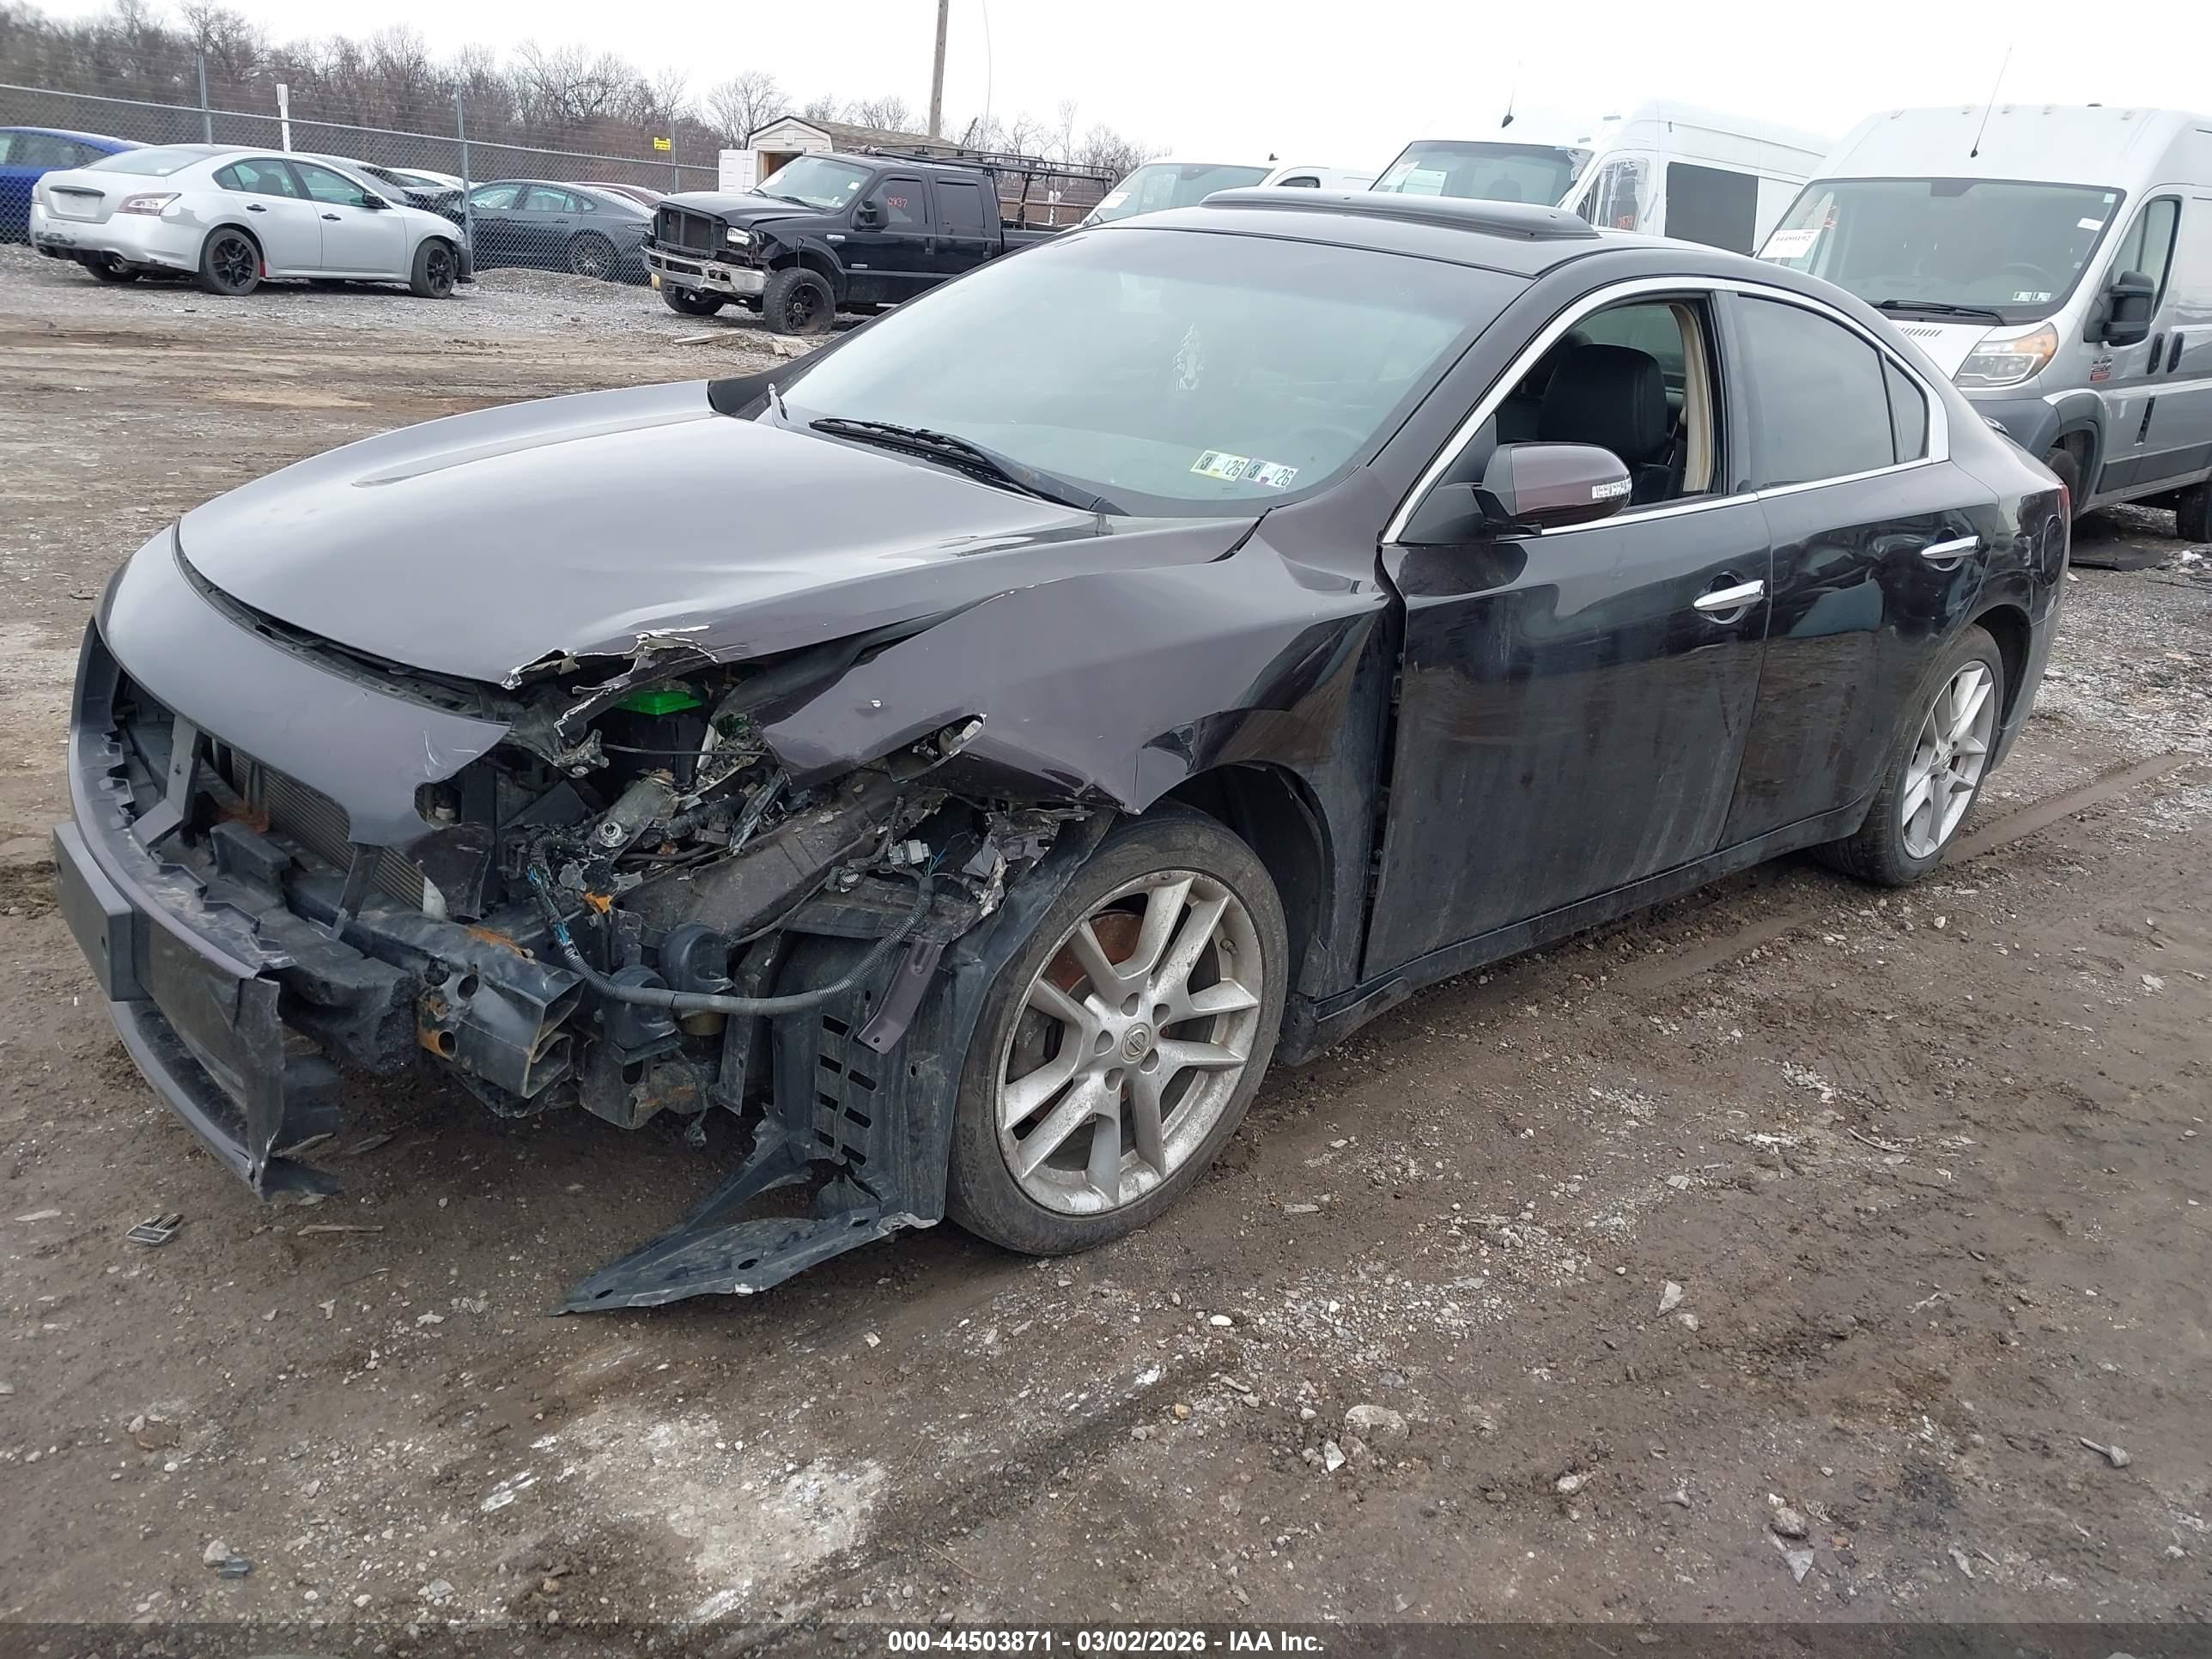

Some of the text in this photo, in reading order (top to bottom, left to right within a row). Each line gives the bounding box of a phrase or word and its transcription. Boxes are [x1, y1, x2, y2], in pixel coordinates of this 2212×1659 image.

[1200, 456, 1245, 477] 3 26
[1248, 465, 1295, 486] 3 26
